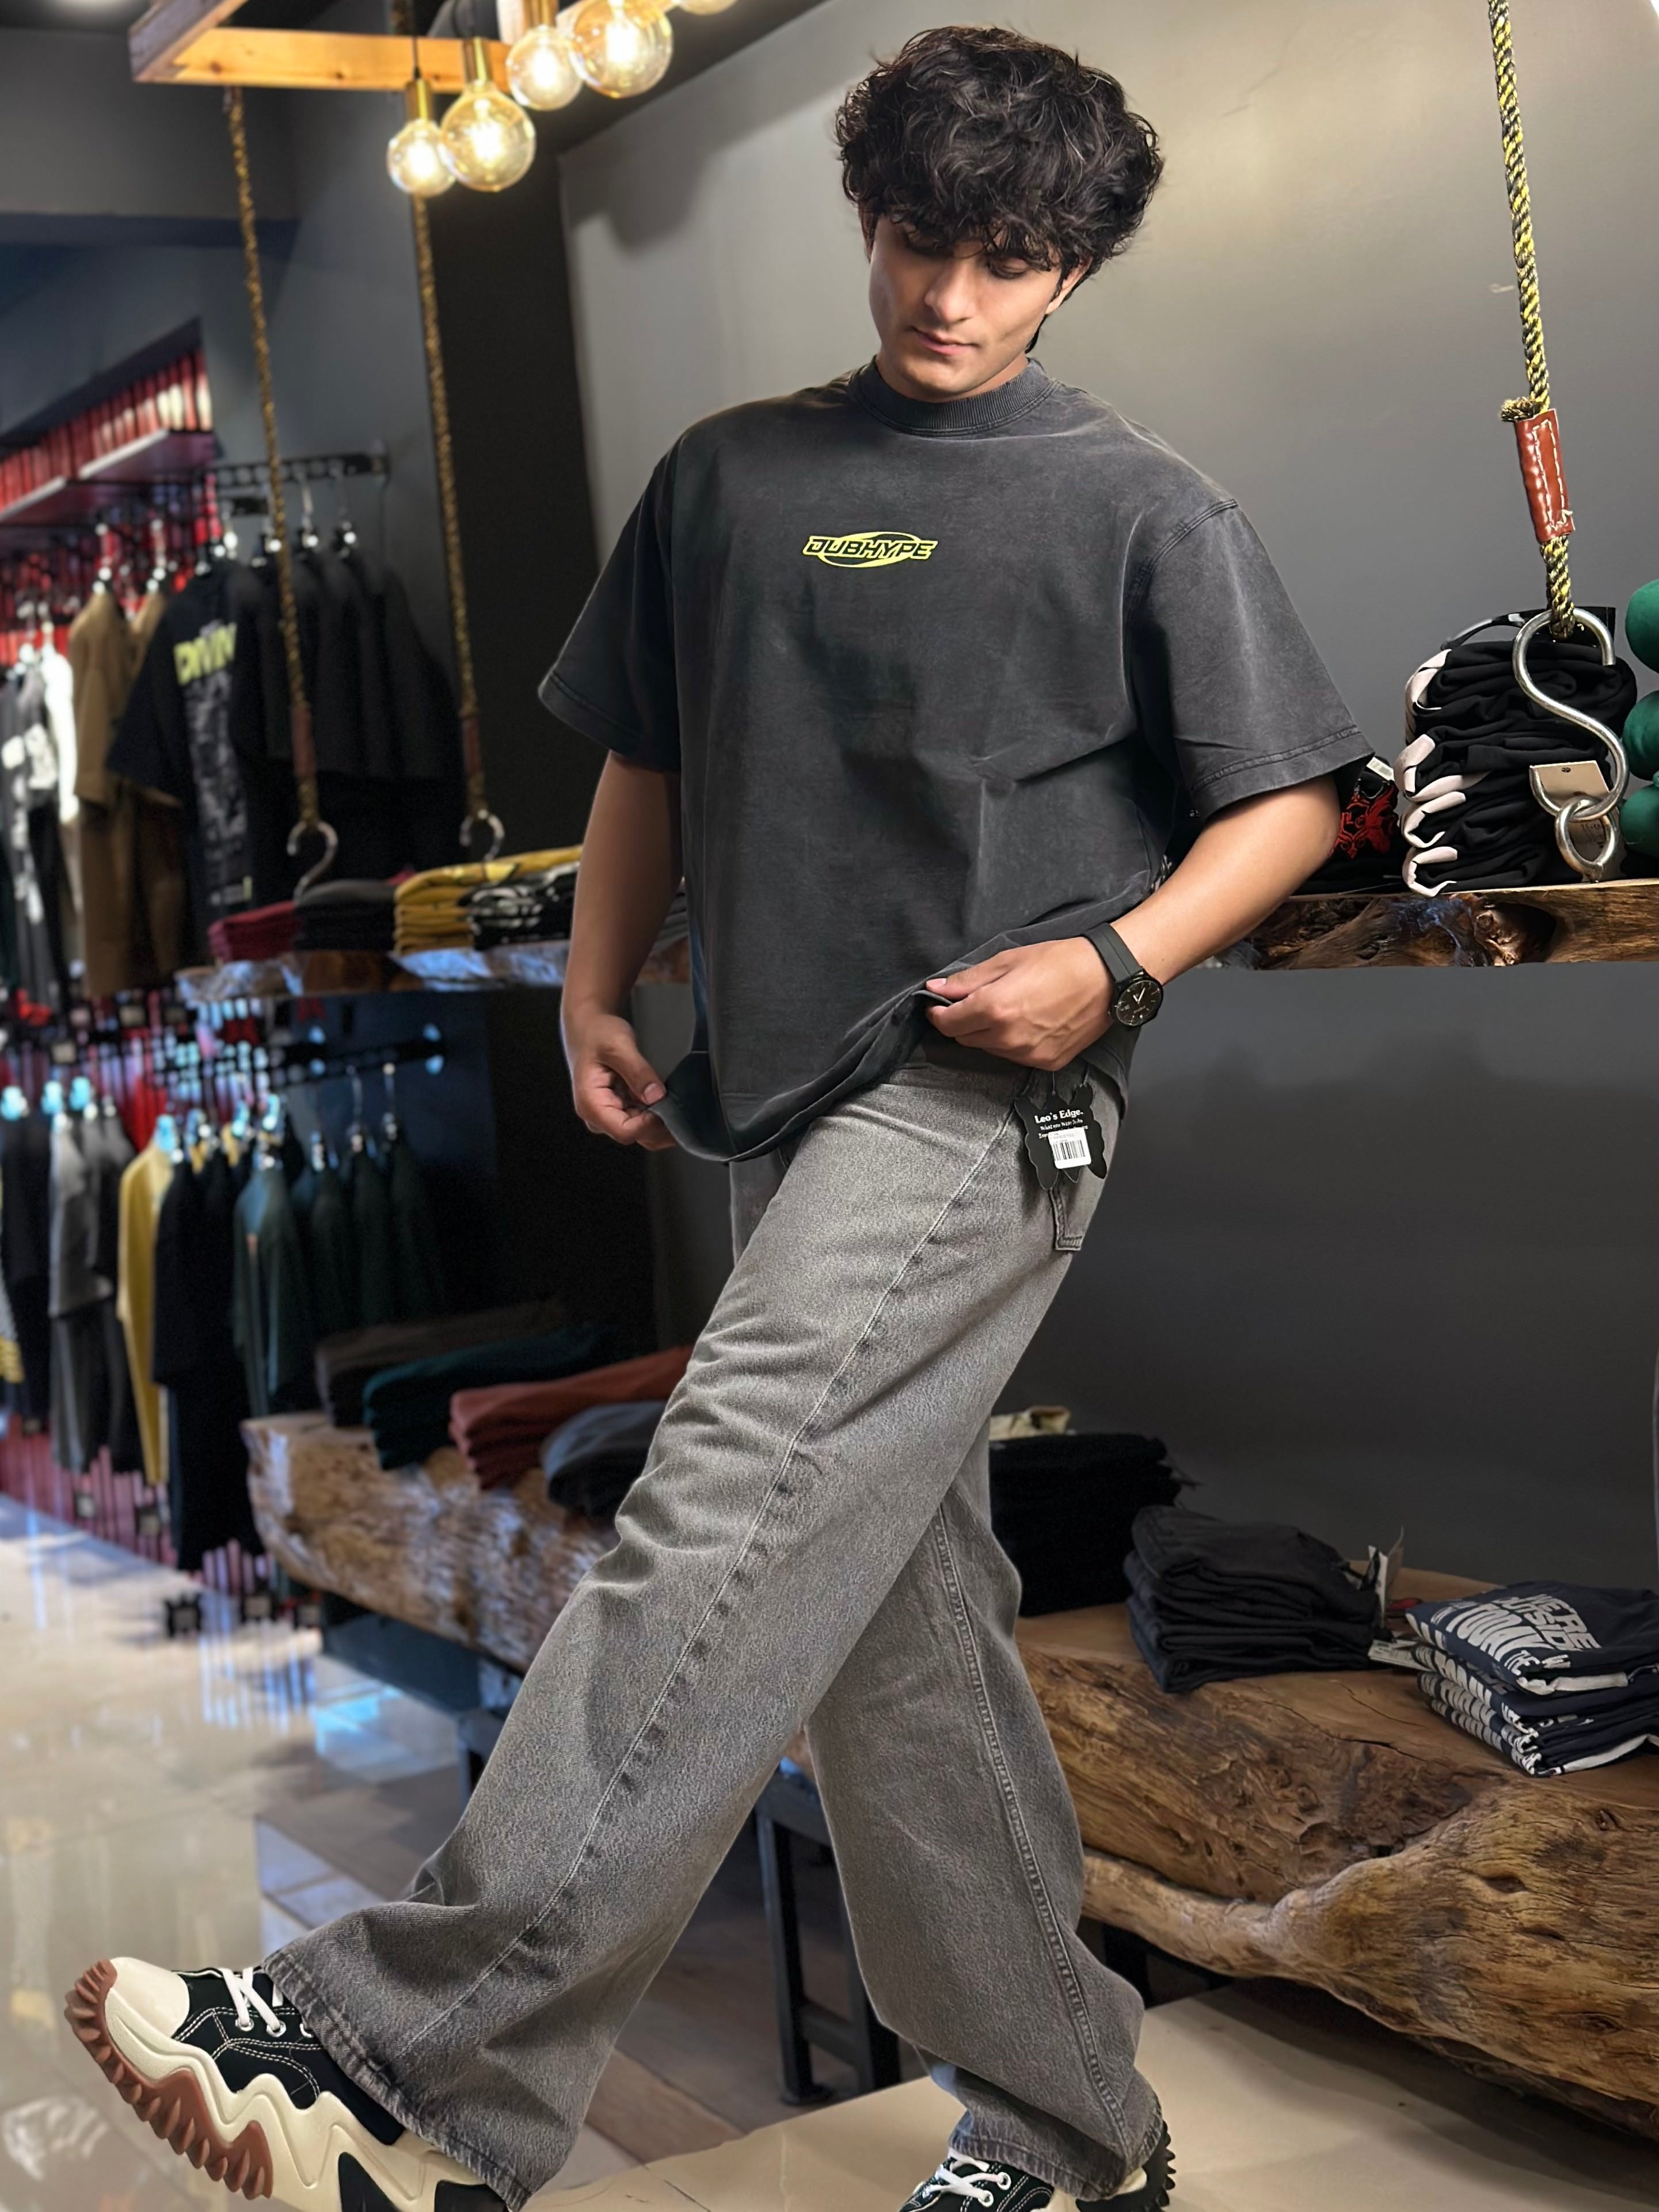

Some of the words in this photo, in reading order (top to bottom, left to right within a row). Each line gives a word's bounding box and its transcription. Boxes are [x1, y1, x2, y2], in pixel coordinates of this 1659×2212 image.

[804, 536, 938, 559] DUBHYPE
[1034, 1112, 1058, 1124] Leo's
[1059, 1109, 1083, 1118] Edge.
[1491, 1597, 1584, 1651] OUTSID
